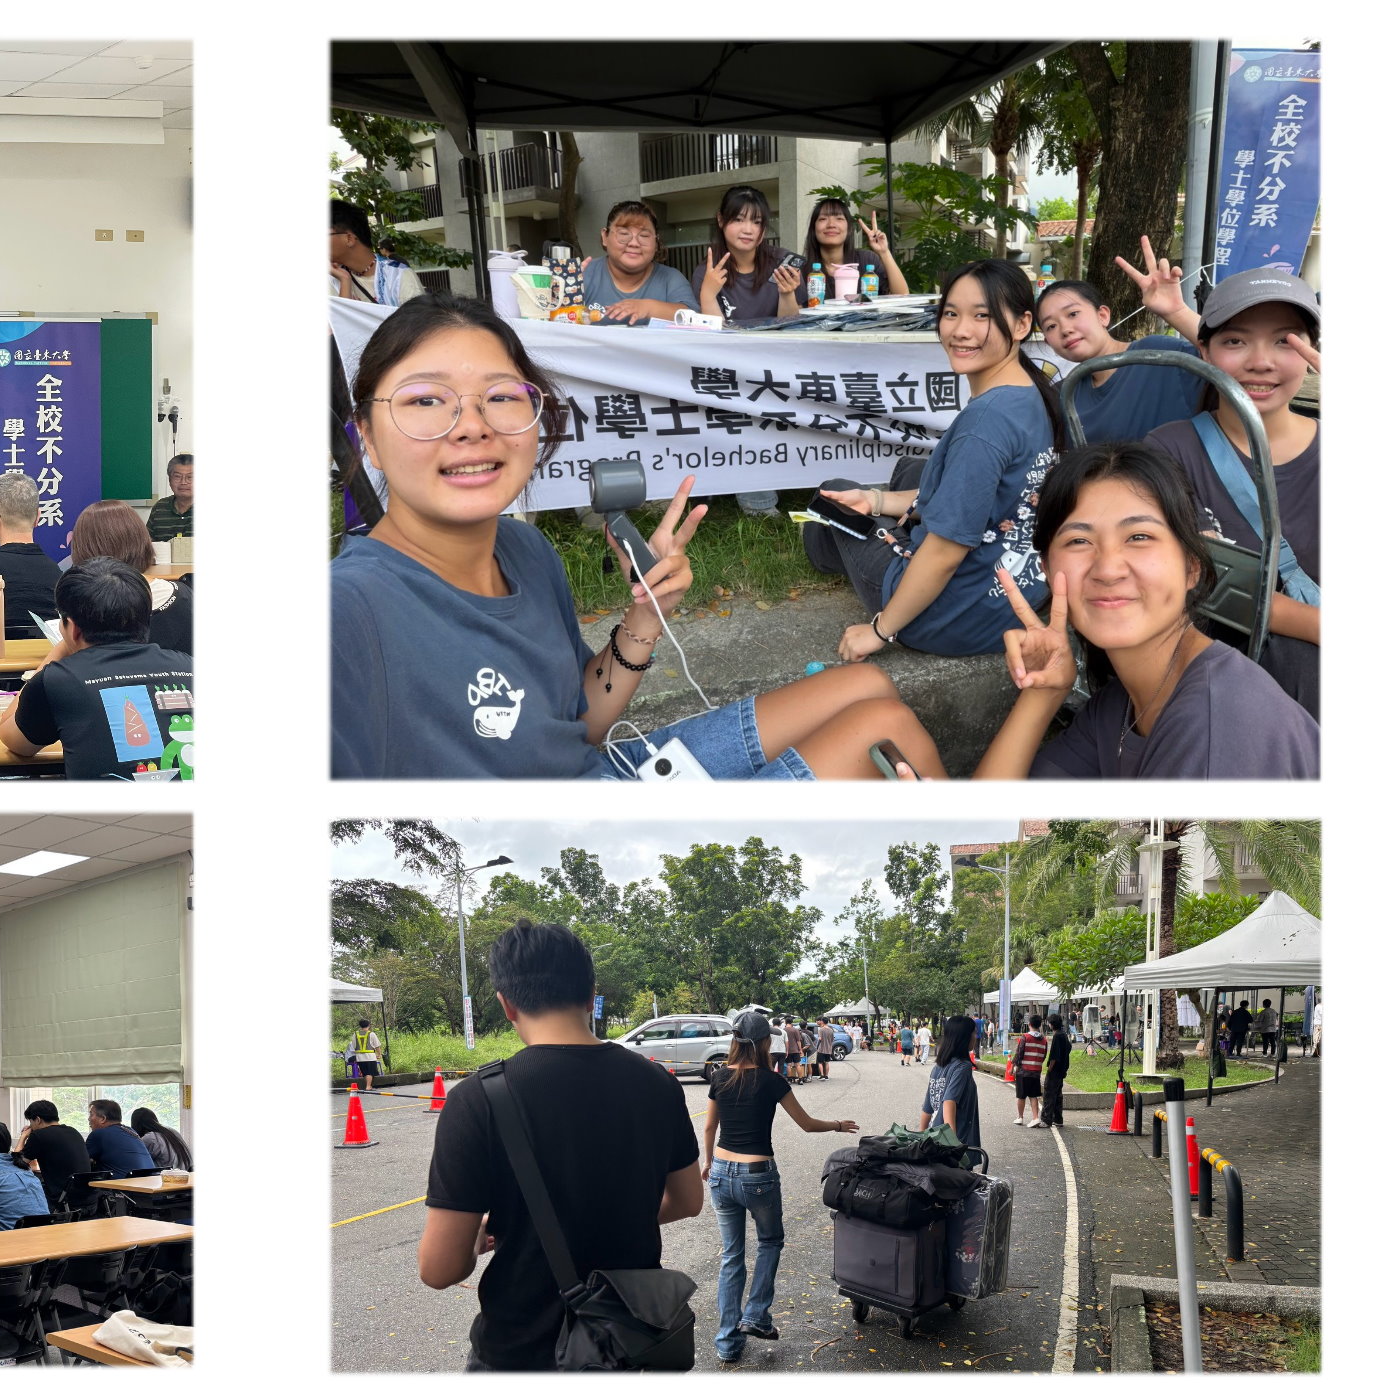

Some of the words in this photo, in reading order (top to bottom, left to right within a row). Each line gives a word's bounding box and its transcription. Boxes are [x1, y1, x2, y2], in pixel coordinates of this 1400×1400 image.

[1248, 93, 1308, 228] 全校不分系
[36, 373, 64, 527] 全校不分系
